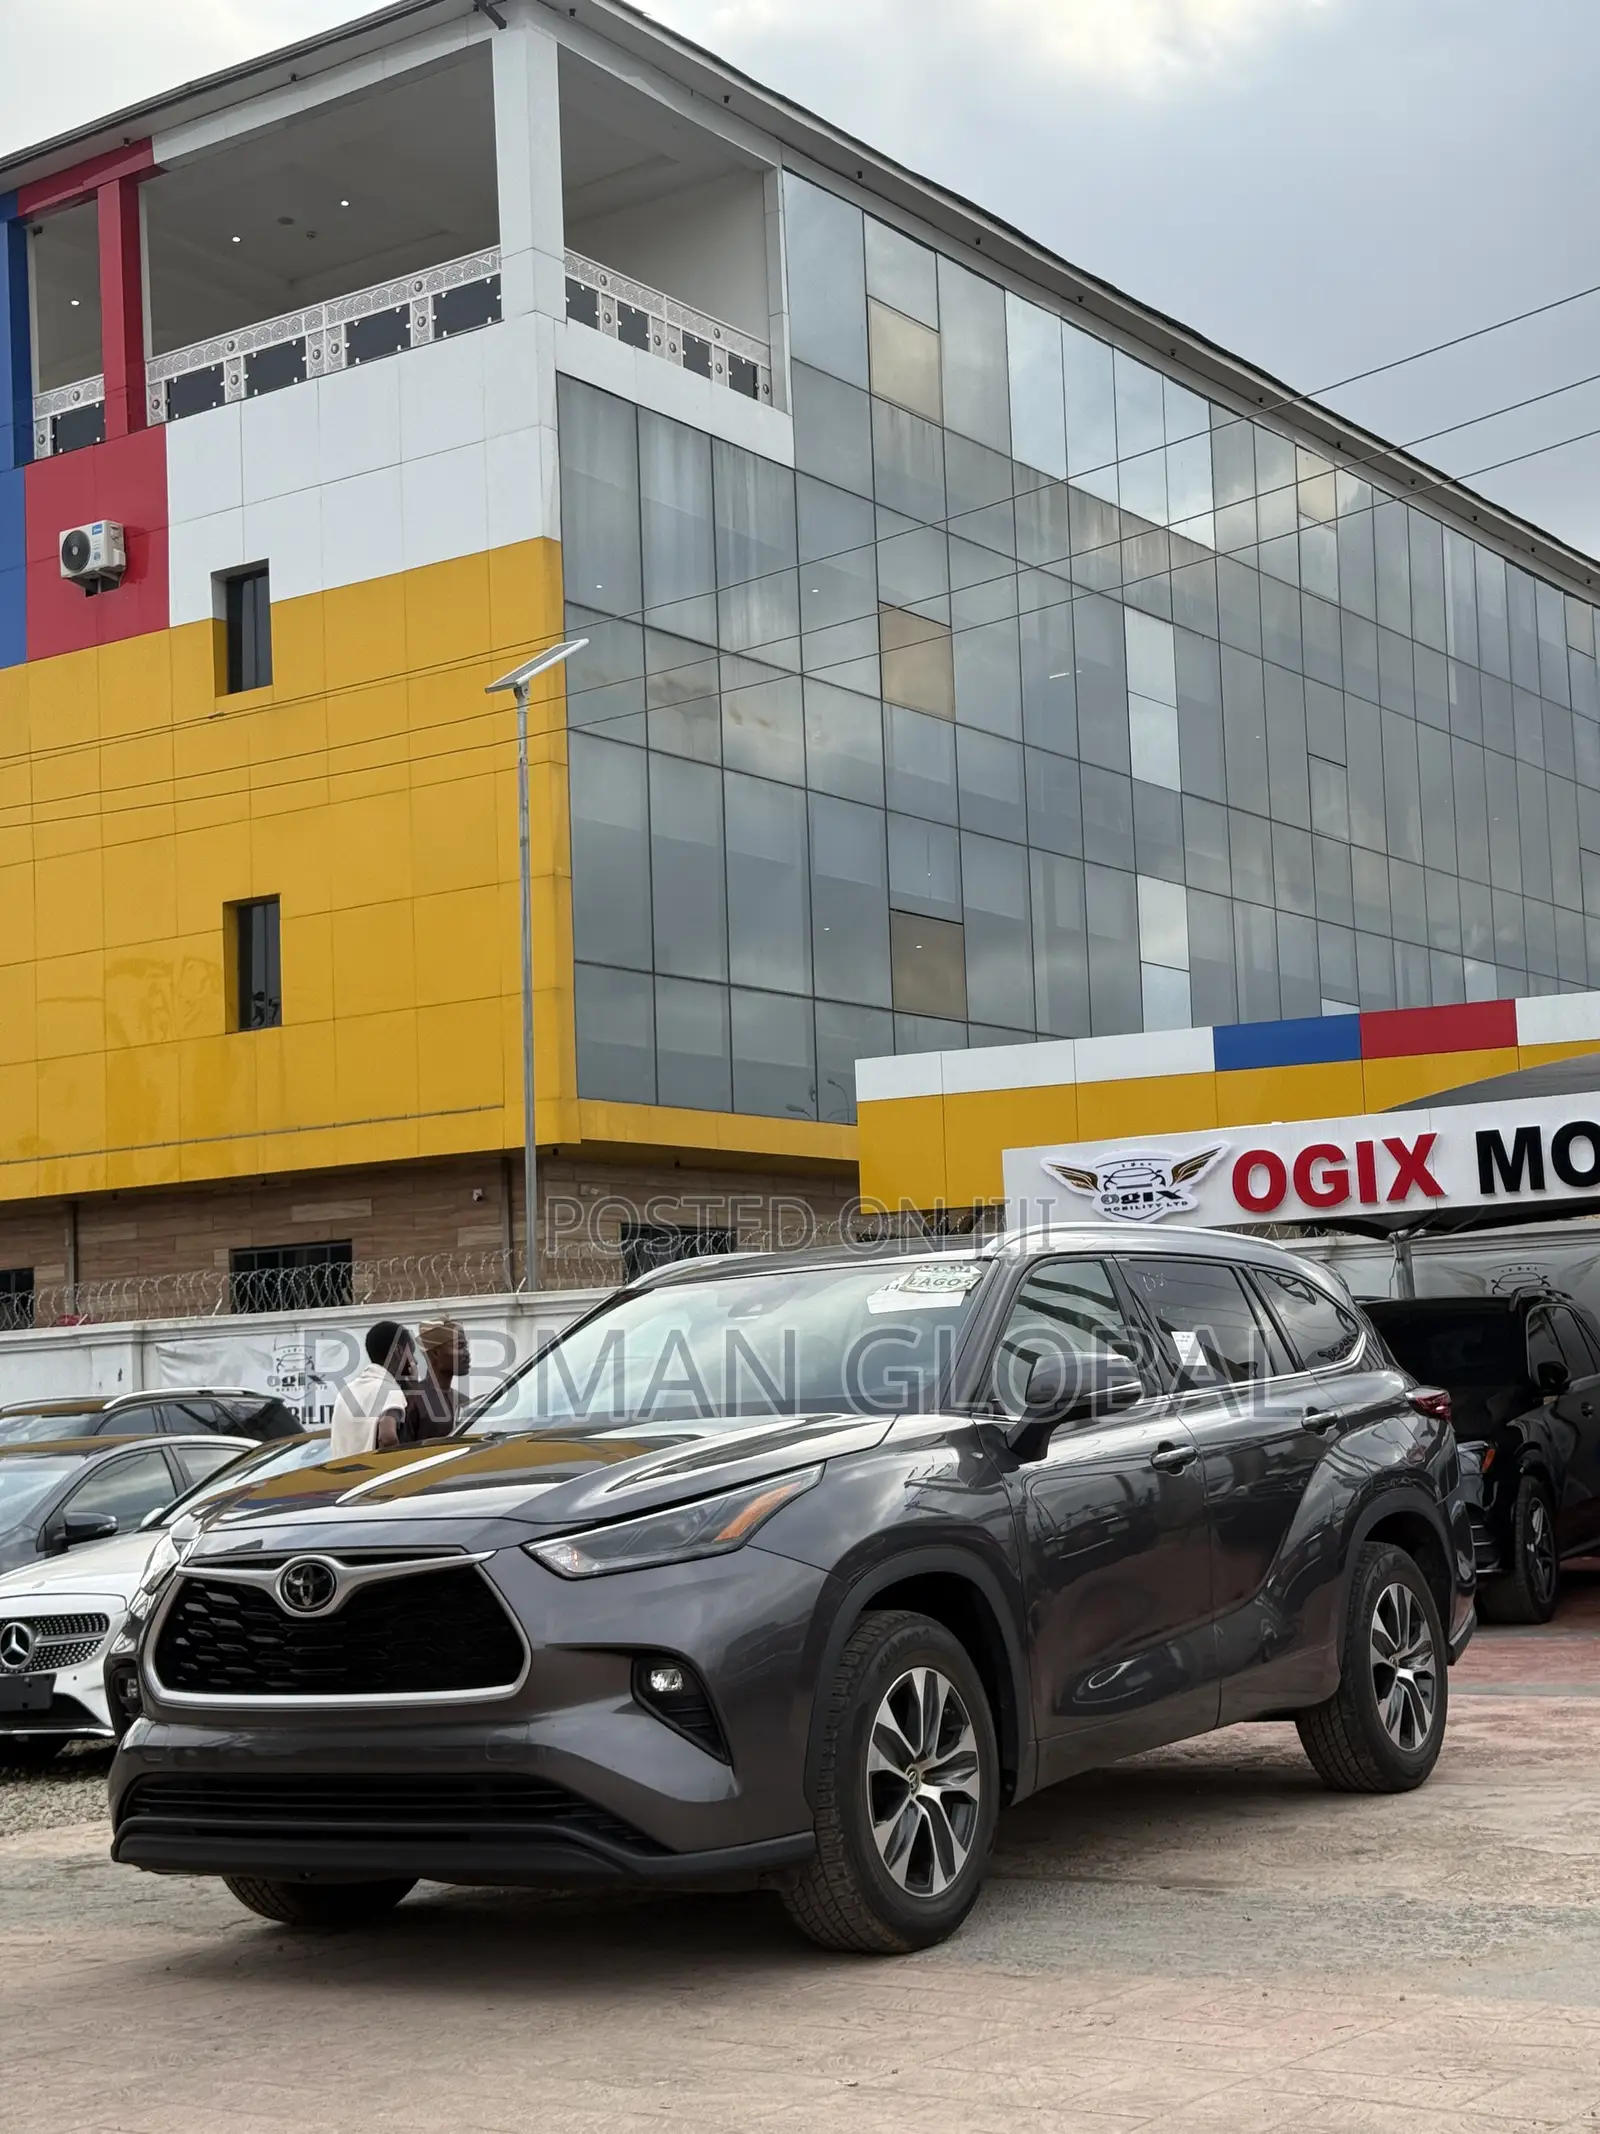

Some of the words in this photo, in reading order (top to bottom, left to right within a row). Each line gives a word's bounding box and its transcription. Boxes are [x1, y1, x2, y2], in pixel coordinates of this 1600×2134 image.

[1232, 1132, 1446, 1214] OGIX
[1104, 1202, 1162, 1212] MOBILITY
[1167, 1200, 1188, 1208] LTD
